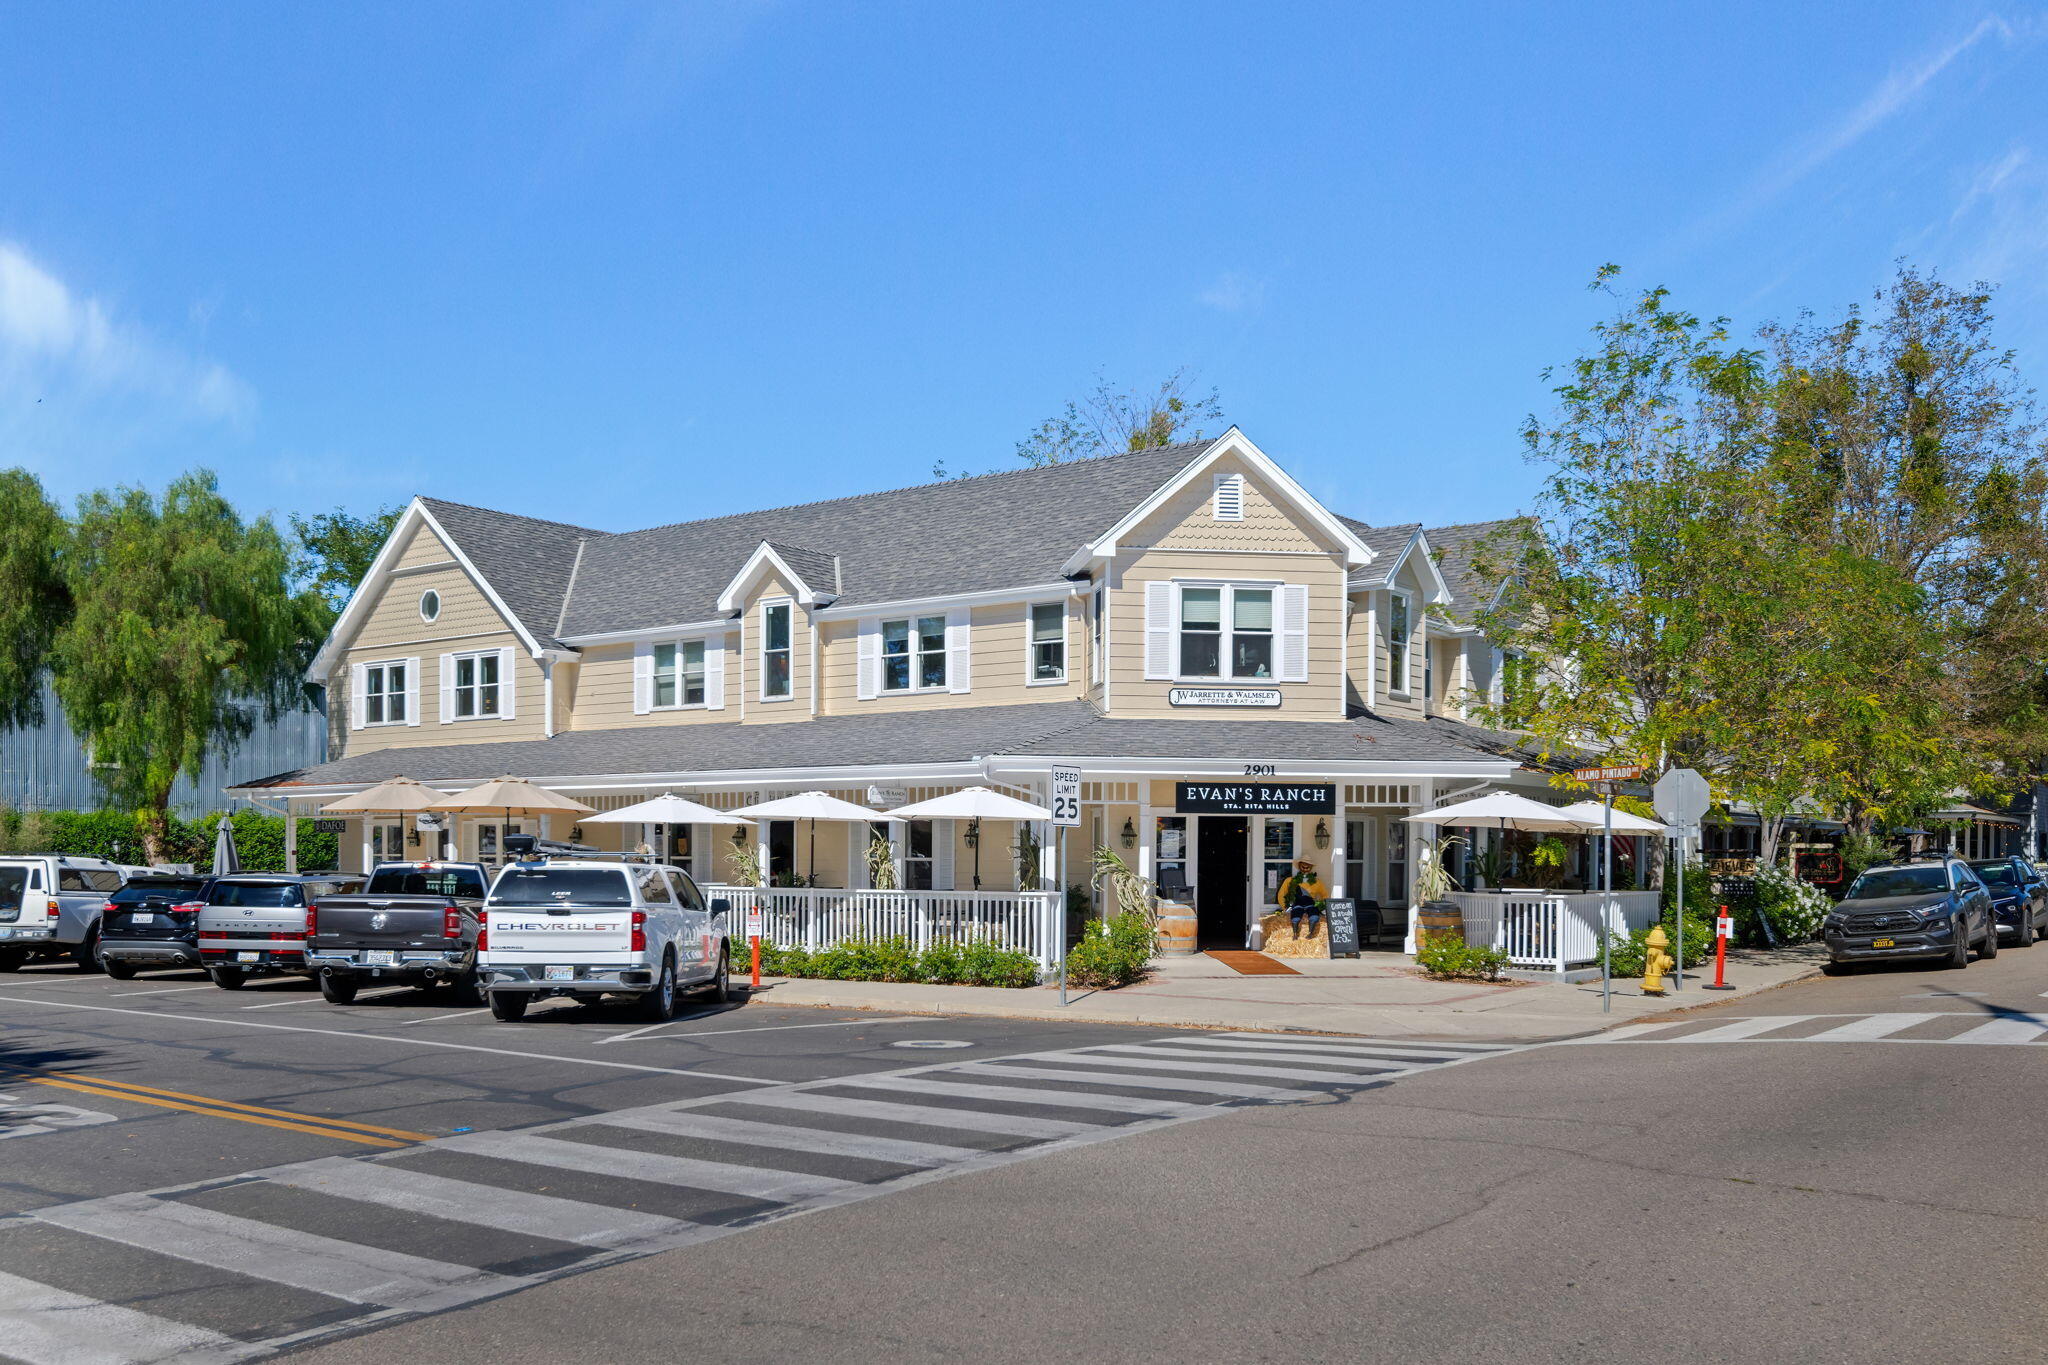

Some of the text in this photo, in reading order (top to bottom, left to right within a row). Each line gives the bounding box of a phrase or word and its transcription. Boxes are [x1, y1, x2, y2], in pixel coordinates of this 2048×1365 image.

[1244, 765, 1276, 776] 2901
[1576, 770, 1600, 780] ALAMO
[1602, 767, 1632, 778] PINTADO
[1055, 772, 1079, 782] SPEED
[1057, 785, 1076, 794] LIMIT
[1187, 787, 1326, 801] EVAN'S RANCH
[1055, 797, 1078, 819] 25
[321, 821, 345, 830] DAFOE
